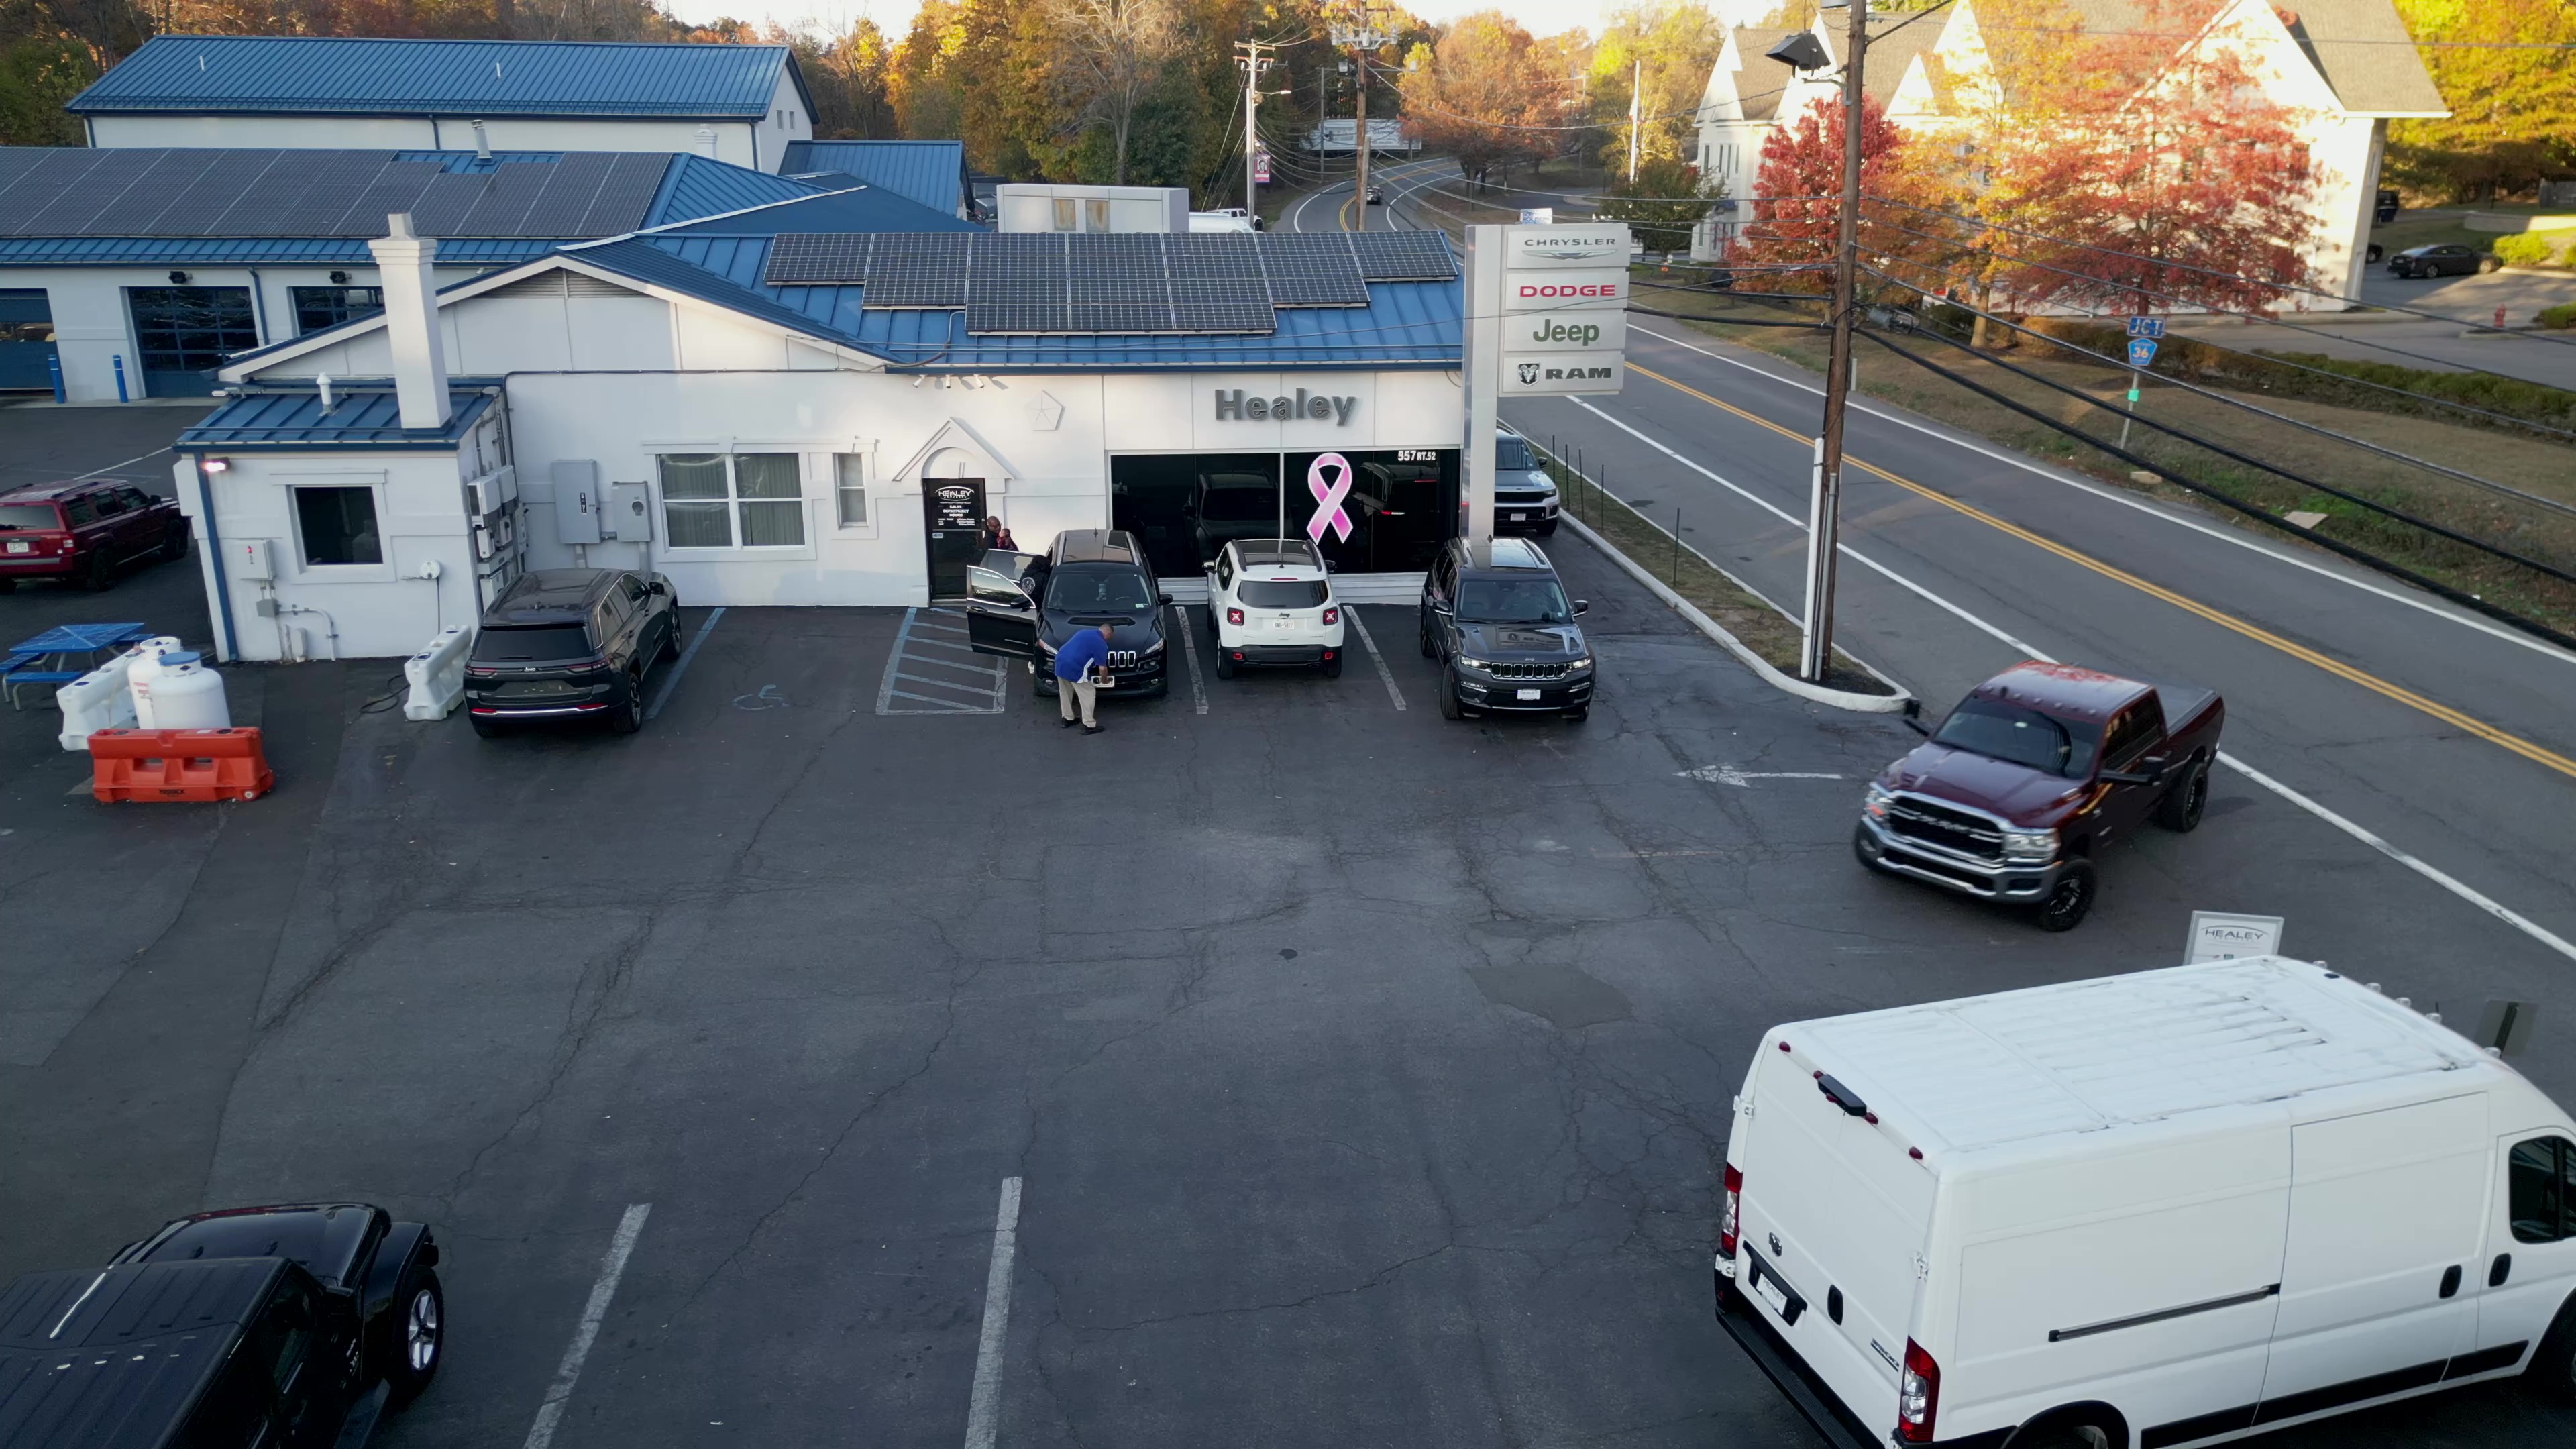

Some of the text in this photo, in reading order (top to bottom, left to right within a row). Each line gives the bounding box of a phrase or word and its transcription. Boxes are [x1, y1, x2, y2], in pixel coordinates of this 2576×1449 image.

[1524, 238, 1616, 246] CHRYSLER
[1519, 284, 1616, 297] DODGE
[1533, 319, 1600, 346] Jeep
[2130, 319, 2162, 335] JCT
[2133, 347, 2149, 358] 36
[1545, 367, 1611, 380] RAM
[1214, 388, 1356, 426] Healey
[1397, 450, 1416, 462] 557
[2205, 929, 2264, 940] HEALEY
